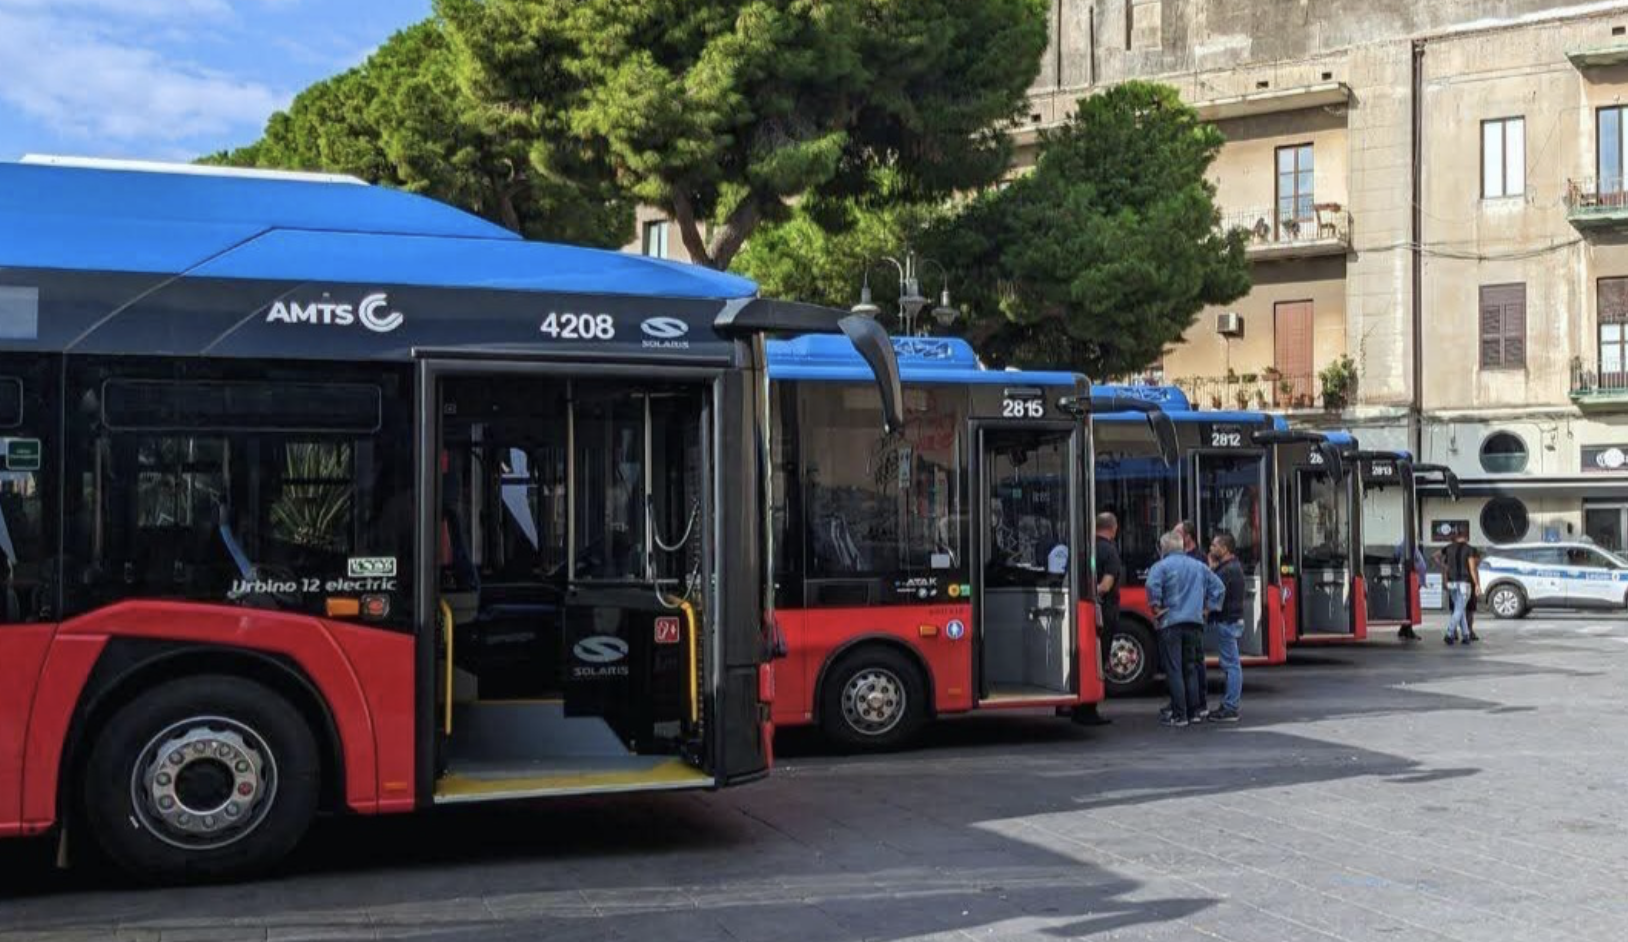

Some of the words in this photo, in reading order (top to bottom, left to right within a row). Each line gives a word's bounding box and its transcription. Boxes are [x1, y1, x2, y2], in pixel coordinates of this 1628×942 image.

[266, 301, 354, 325] AMTS
[540, 312, 615, 339] 4208
[641, 340, 689, 348] SOLARIS
[1003, 399, 1043, 417] 2815
[1212, 433, 1241, 446] 2812
[227, 579, 297, 598] Urbino
[302, 578, 320, 592] 12
[325, 577, 397, 591] electric
[574, 666, 629, 676] SOLARIS
